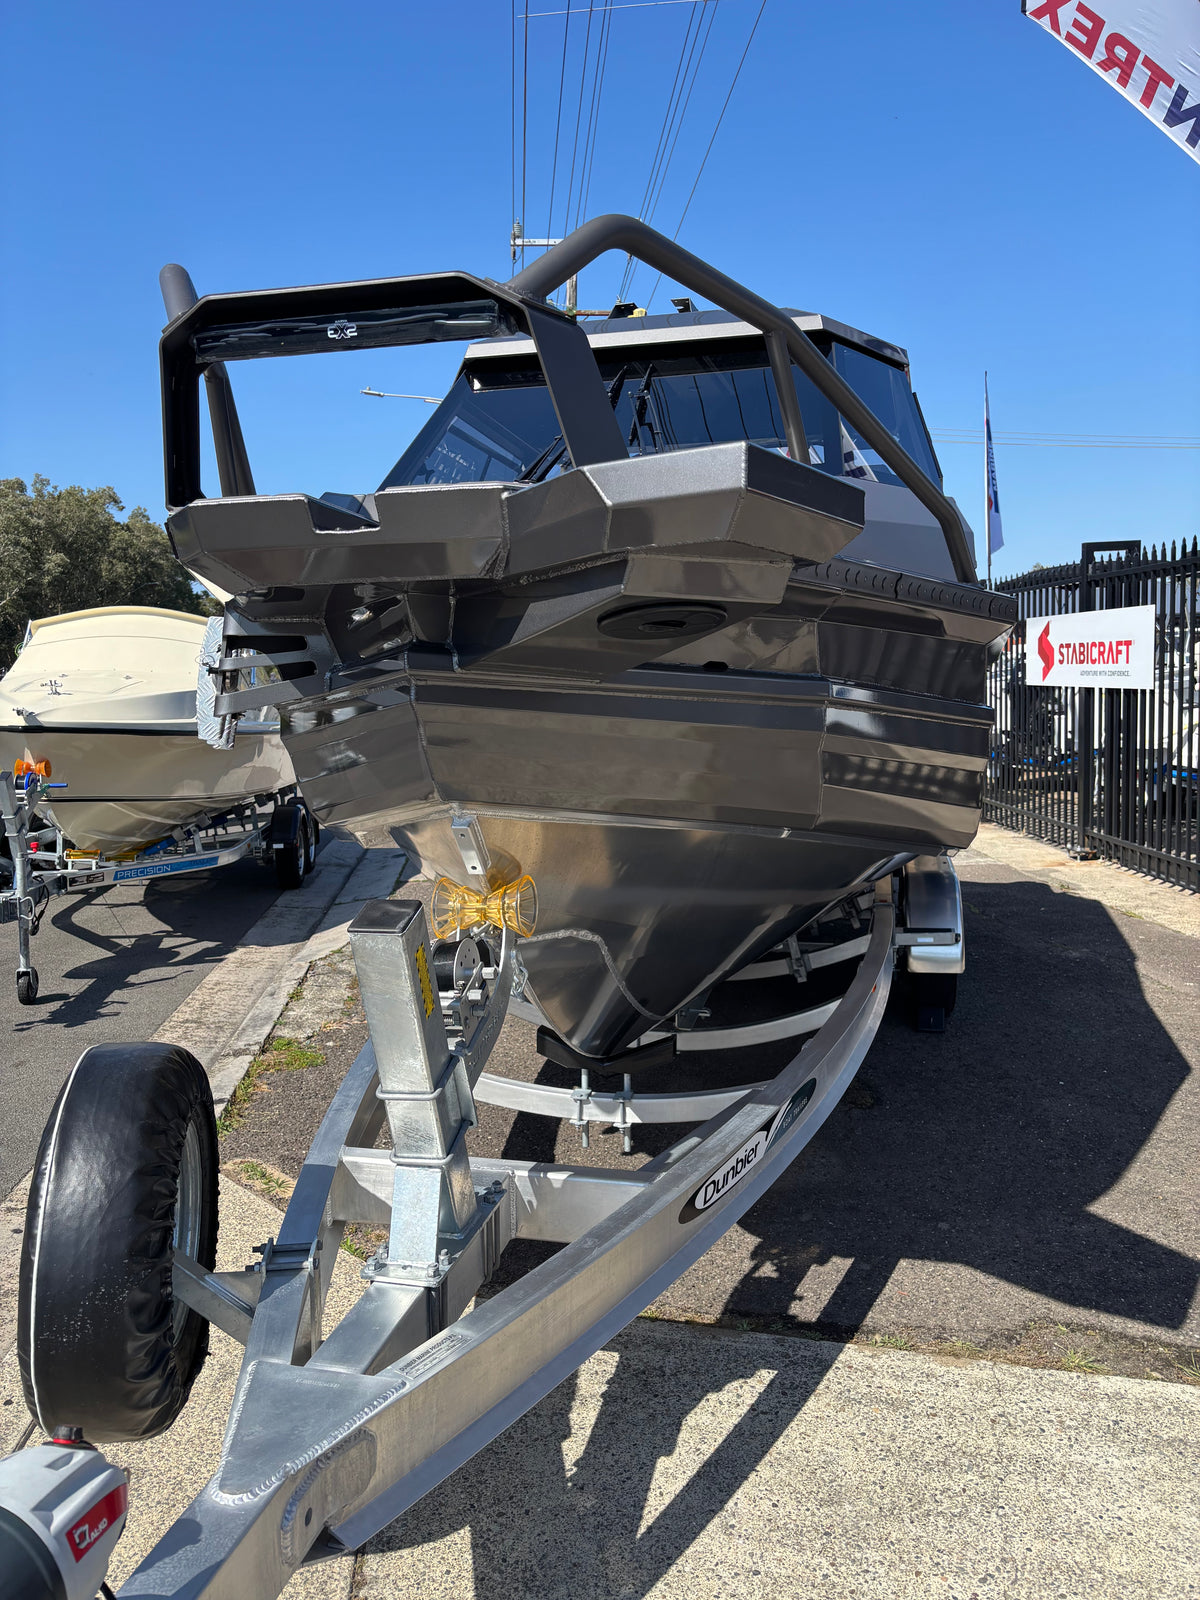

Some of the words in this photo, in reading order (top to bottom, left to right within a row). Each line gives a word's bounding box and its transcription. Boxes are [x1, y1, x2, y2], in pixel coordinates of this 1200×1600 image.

[1058, 640, 1132, 665] STABICRAFT
[118, 864, 171, 879] PRECISION
[703, 1141, 760, 1207] Dunbier
